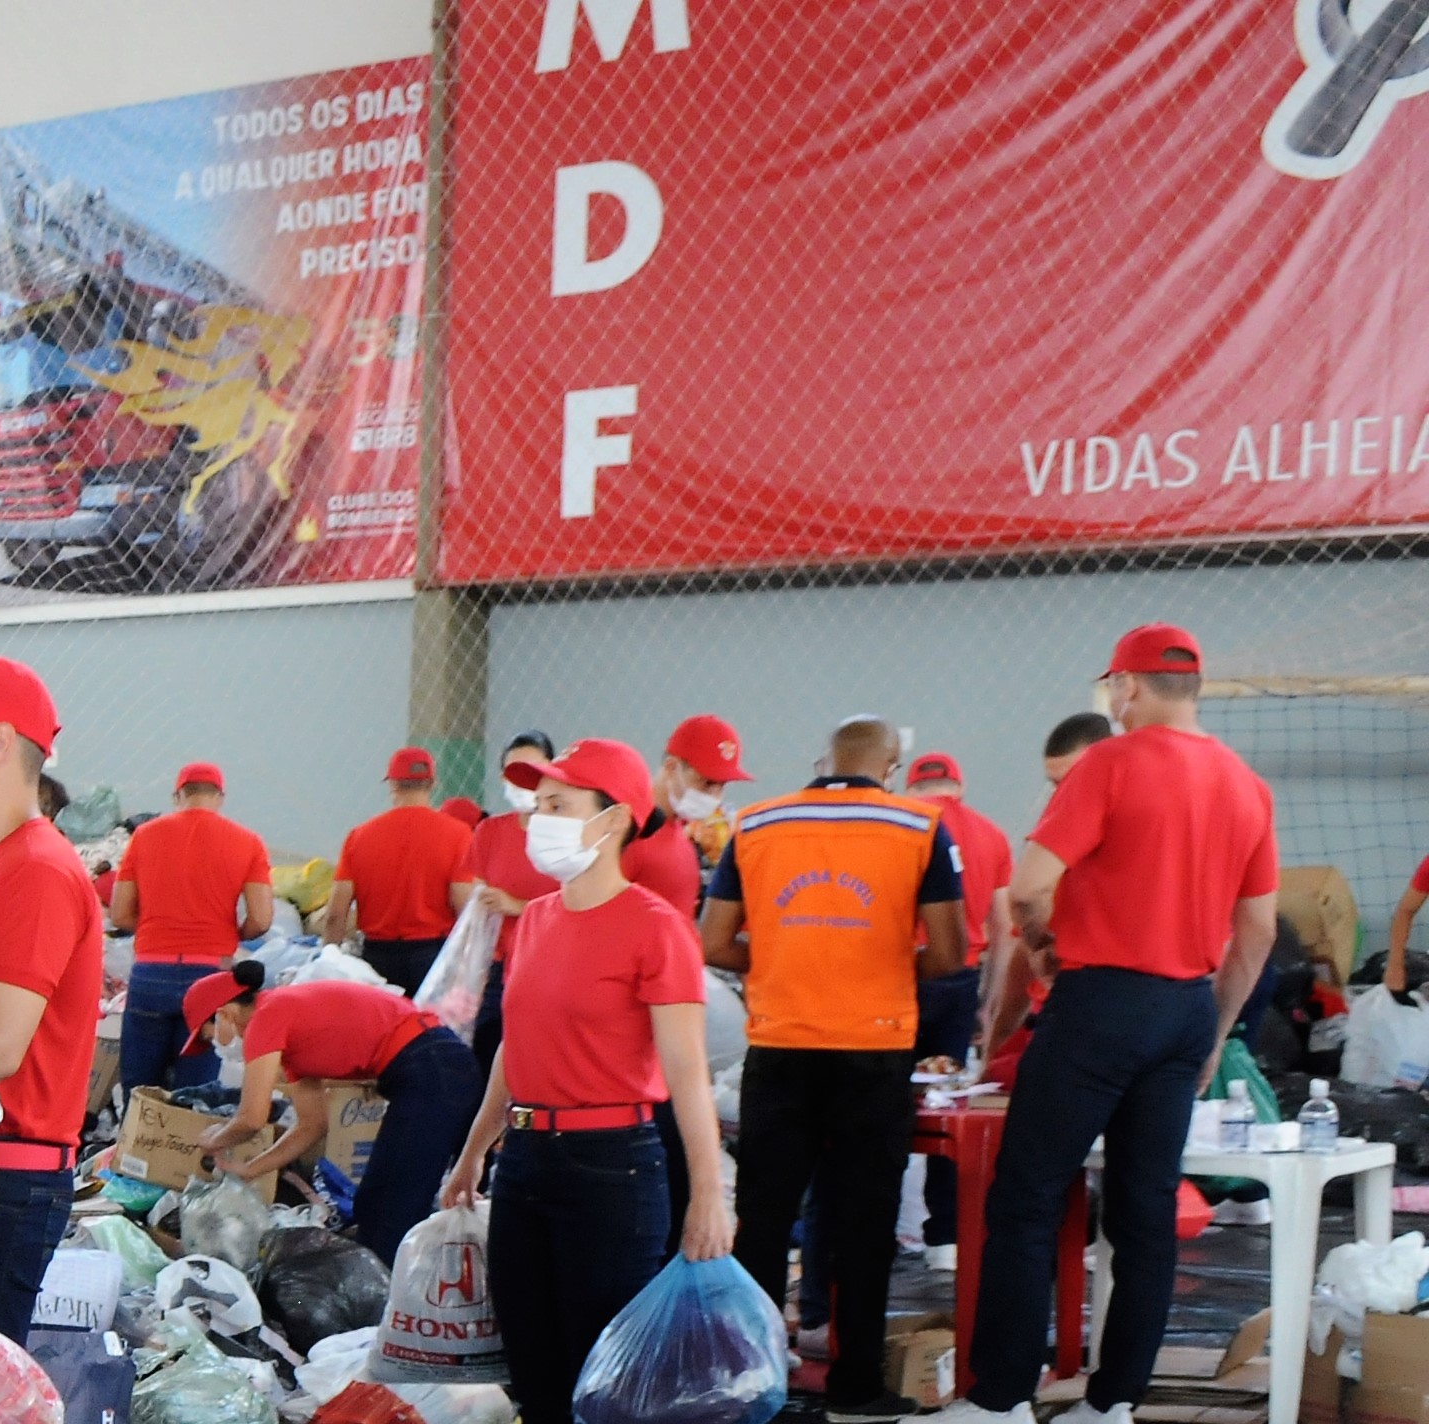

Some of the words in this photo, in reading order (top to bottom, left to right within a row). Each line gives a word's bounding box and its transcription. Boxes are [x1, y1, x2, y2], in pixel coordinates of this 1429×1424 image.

[213, 104, 304, 145] TODOS
[310, 95, 350, 130] OS
[356, 82, 425, 124] DIAS
[174, 171, 194, 200] A
[200, 147, 338, 198] QUALQUER
[343, 134, 423, 175] HORA
[276, 192, 367, 235] AONDE
[372, 182, 428, 220] FOR
[1020, 427, 1200, 499] VIDAS
[774, 869, 832, 909] DEFESA
[837, 872, 875, 909] CIVIL
[390, 1310, 500, 1340] HOND
